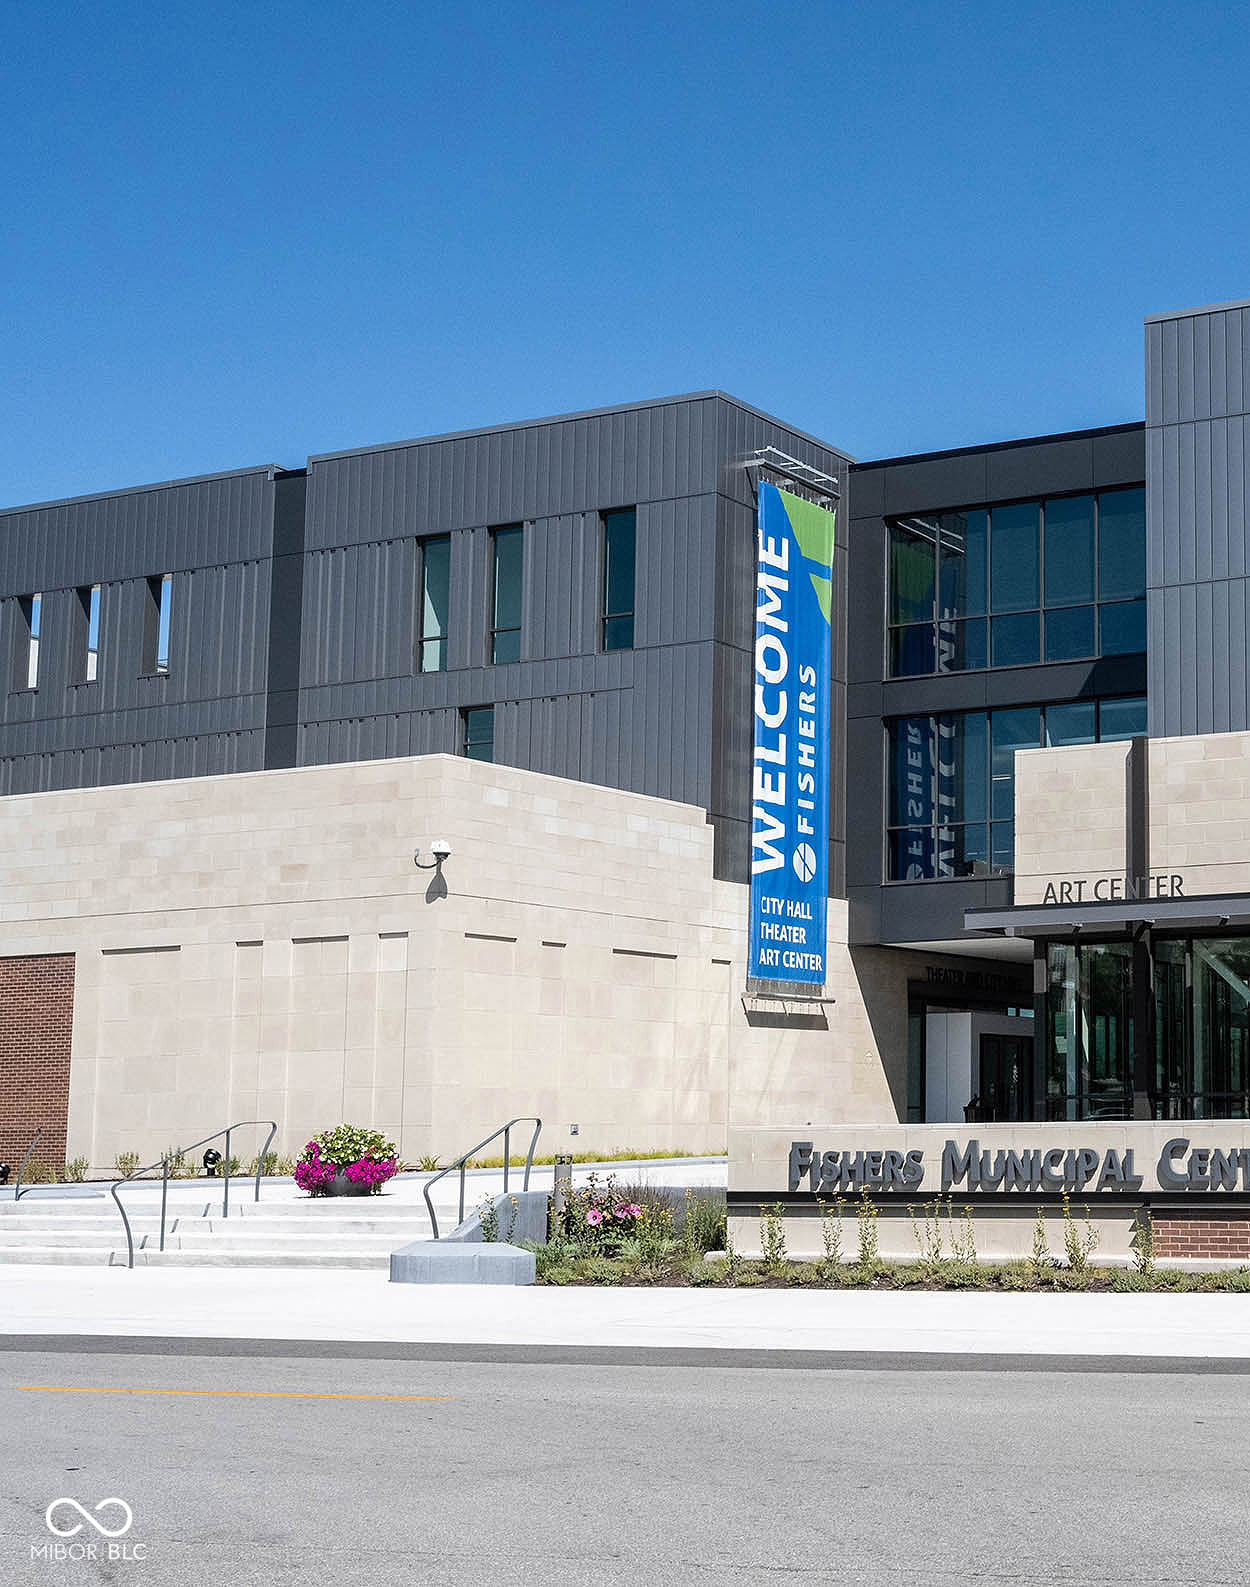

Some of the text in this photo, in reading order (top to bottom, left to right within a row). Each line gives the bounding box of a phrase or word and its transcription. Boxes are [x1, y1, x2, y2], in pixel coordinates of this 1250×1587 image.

[751, 528, 789, 875] WELCOME
[797, 664, 817, 836] FISHERS
[1043, 874, 1185, 904] ART CENTER
[761, 896, 813, 920] CITY HALL
[760, 921, 807, 945] THEATER
[759, 947, 824, 972] ART CENTER
